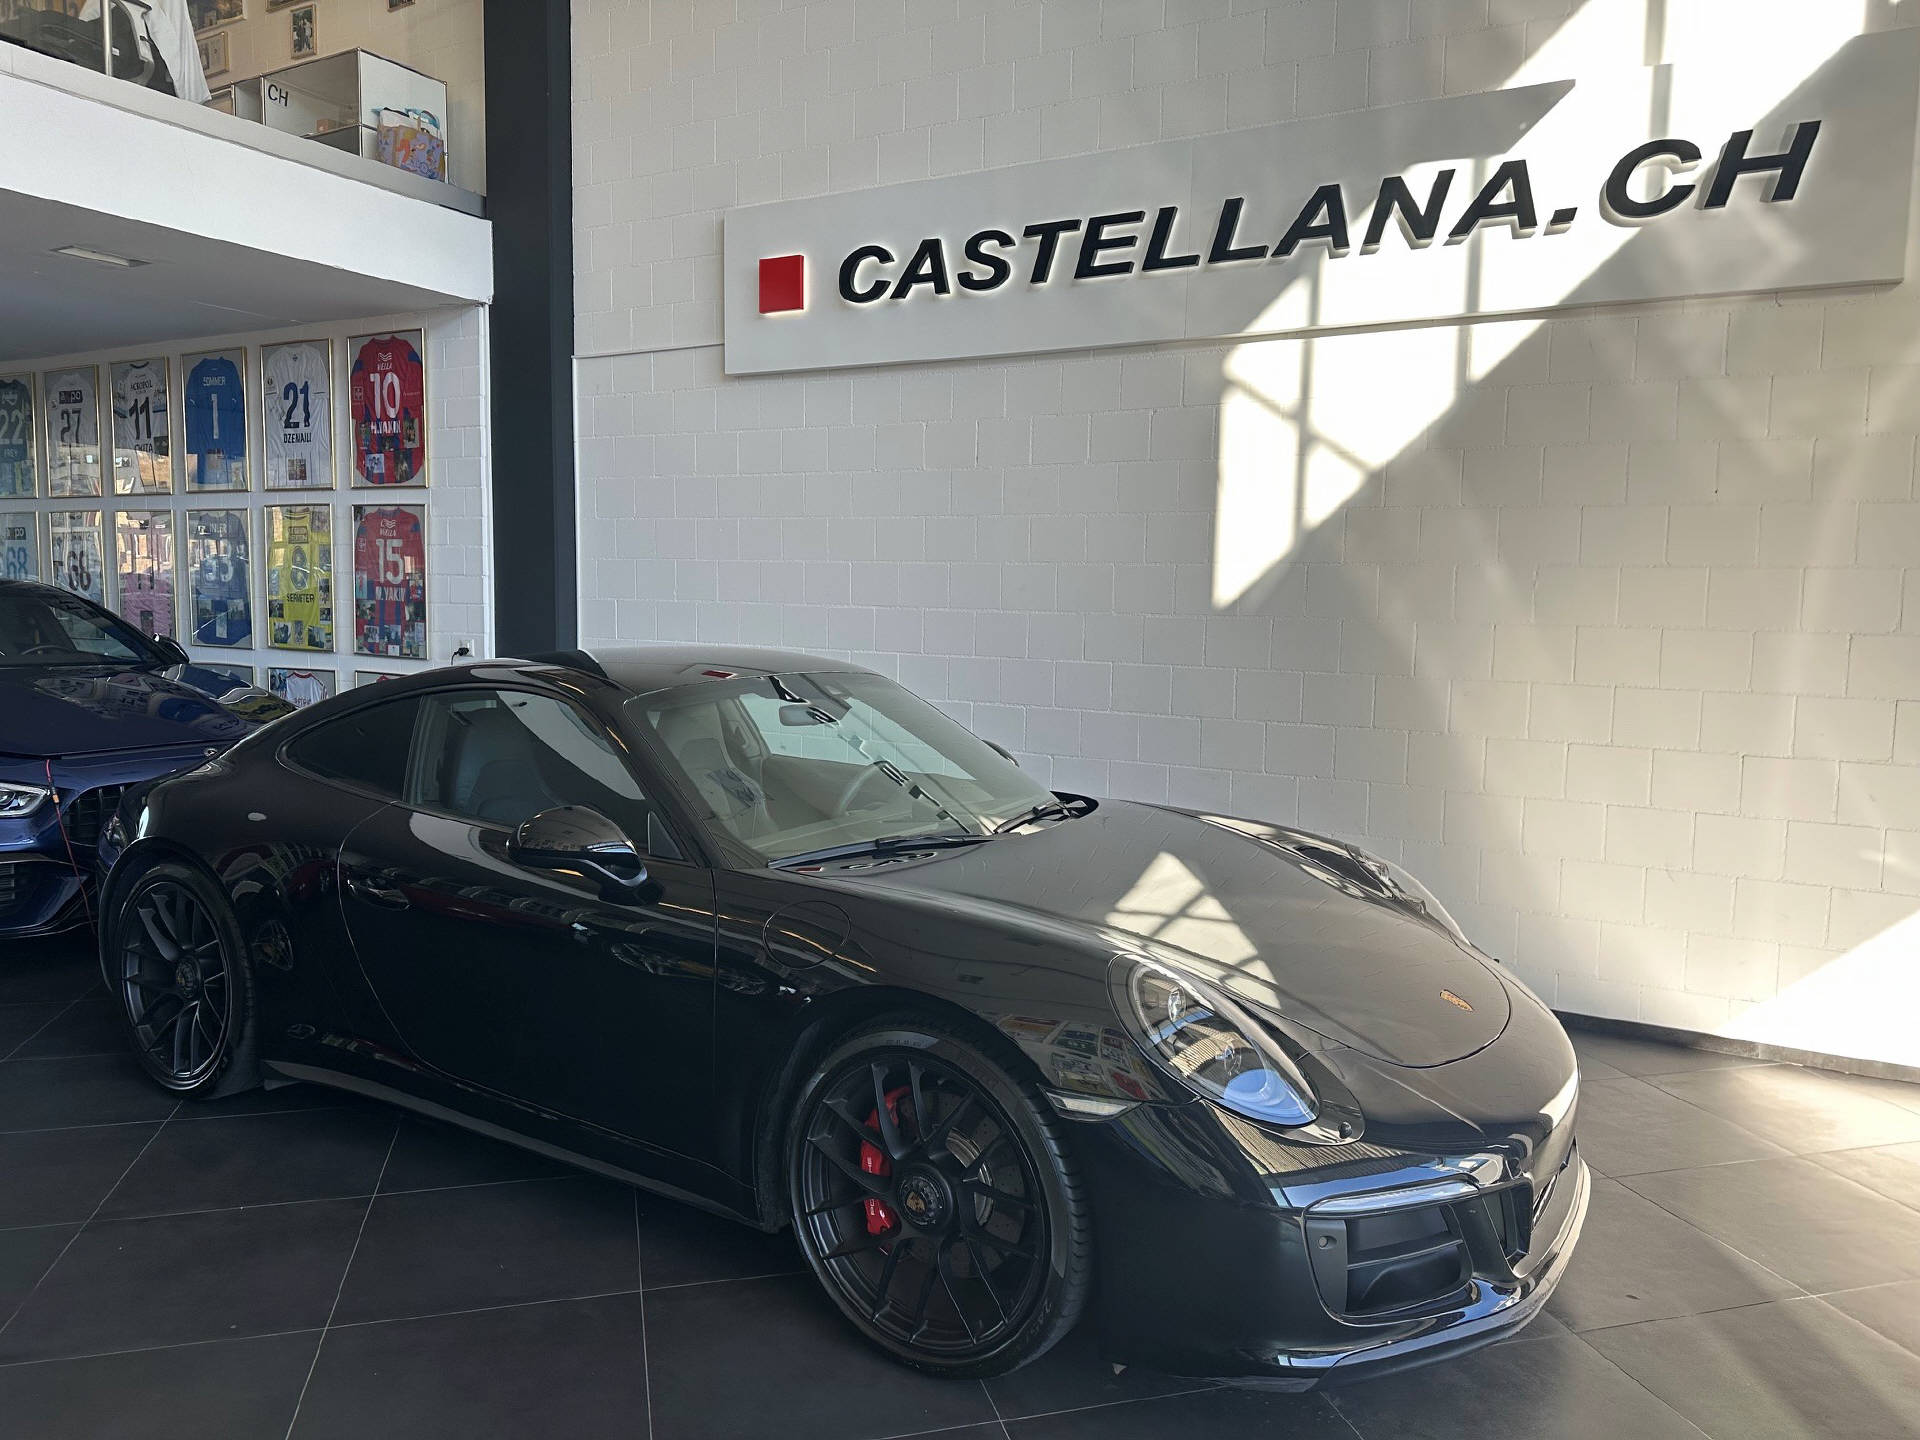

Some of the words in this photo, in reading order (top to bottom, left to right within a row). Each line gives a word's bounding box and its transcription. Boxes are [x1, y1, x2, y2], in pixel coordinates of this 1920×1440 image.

[268, 84, 289, 107] CH
[838, 119, 1822, 304] CASTELLANA.CH
[128, 396, 152, 440] 11
[211, 393, 219, 440] 1
[284, 381, 311, 429] 21
[370, 371, 400, 419] 10
[0, 409, 24, 445] 22
[61, 408, 81, 446] 27
[376, 538, 405, 585] 15
